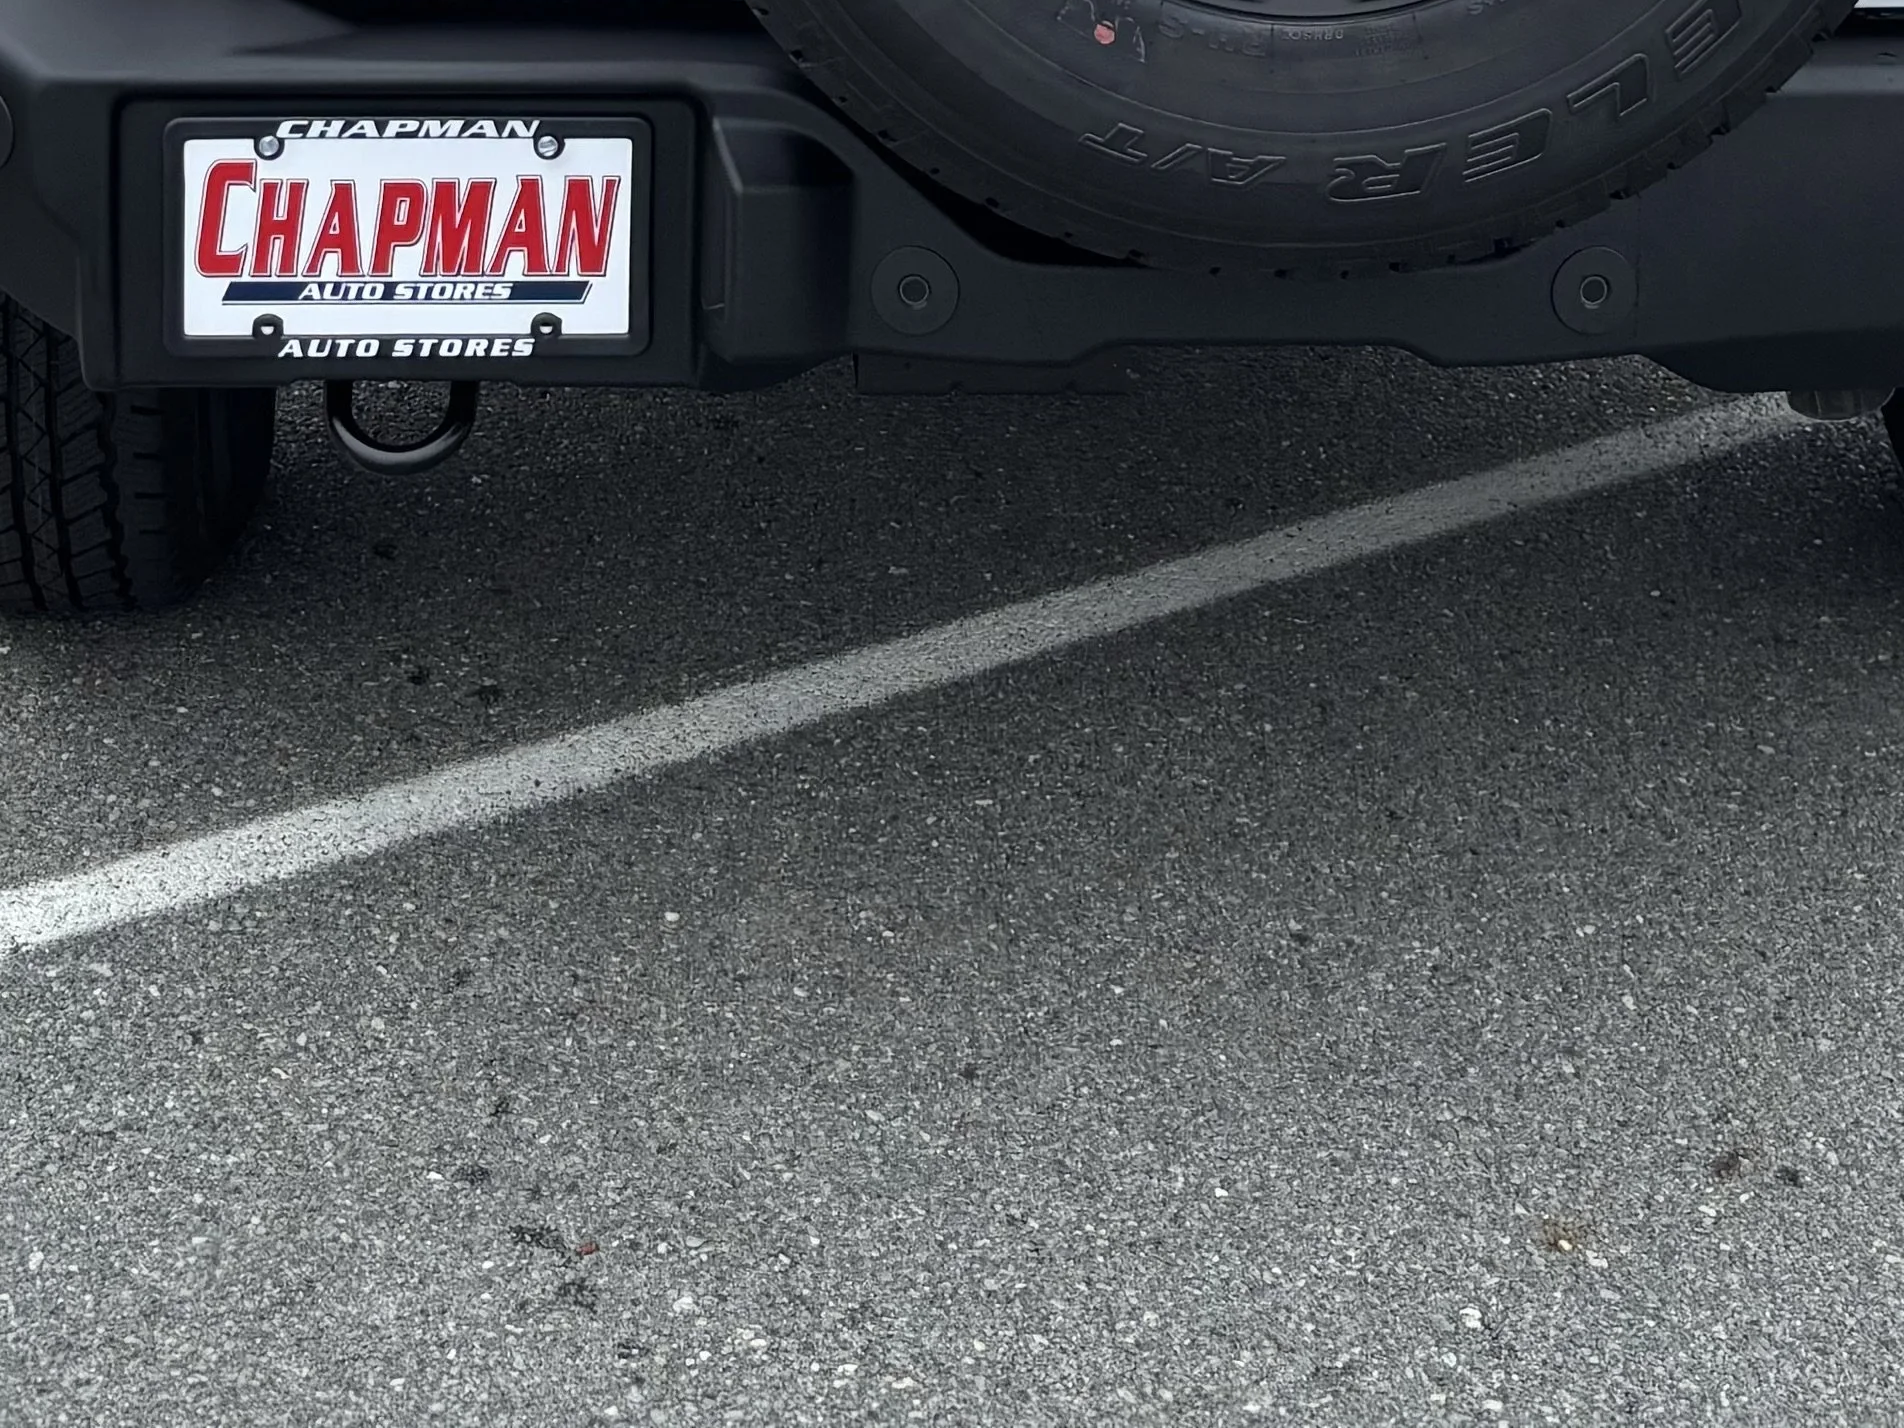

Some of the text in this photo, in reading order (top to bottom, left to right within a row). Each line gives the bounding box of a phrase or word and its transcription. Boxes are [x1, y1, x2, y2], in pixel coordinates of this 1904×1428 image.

[276, 119, 541, 139] CHAPMAN
[1080, 121, 1287, 185] A/T
[194, 158, 621, 277] CHAPMAN
[298, 282, 514, 300] AUTO STORES
[278, 339, 535, 358] AUTO STORES
